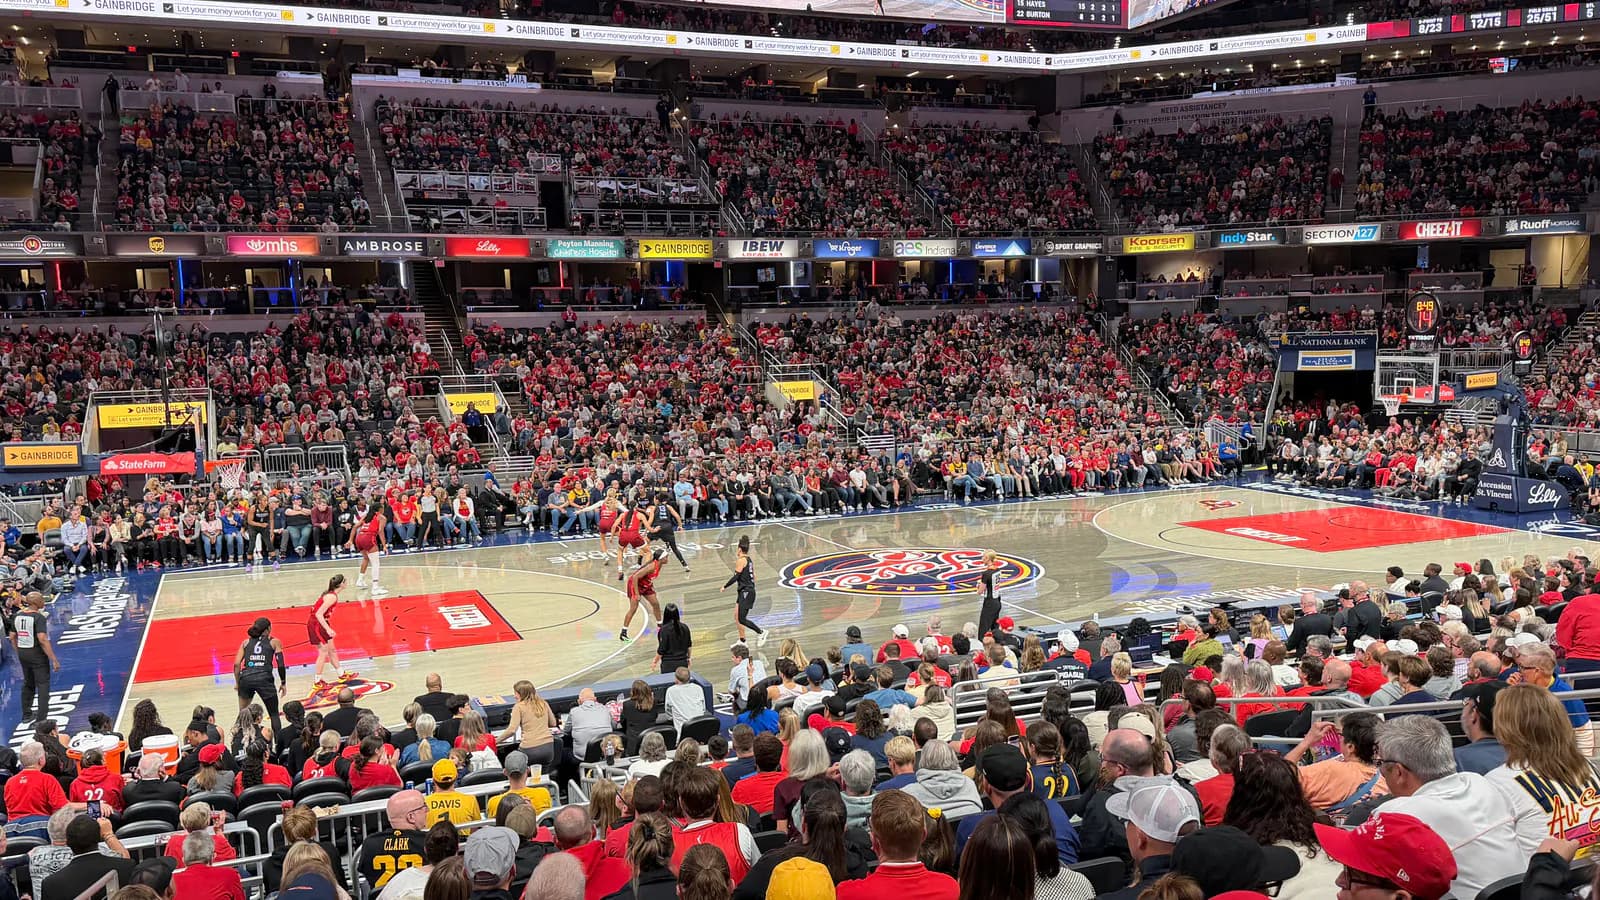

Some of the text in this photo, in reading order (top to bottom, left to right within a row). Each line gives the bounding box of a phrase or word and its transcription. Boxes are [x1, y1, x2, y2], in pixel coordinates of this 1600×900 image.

[95, 0, 155, 12] GAINBRIDGE
[1026, 0, 1046, 8] HAYES
[191, 7, 206, 15] your
[208, 8, 231, 17] money
[1026, 11, 1050, 19] BURTON
[1586, 8, 1594, 18] 5
[317, 12, 370, 25] GAINBRIDGE
[1471, 17, 1501, 29] 12/15
[1527, 12, 1557, 24] 25/51
[403, 20, 416, 28] your
[418, 20, 440, 29] money
[1418, 22, 1442, 34] 8/23
[516, 25, 565, 36] GAINBRIDGE
[594, 32, 606, 40] your
[607, 33, 628, 41] money
[695, 37, 739, 48] GAINBRIDGE
[765, 43, 776, 51] your
[1232, 40, 1243, 48] your
[1244, 39, 1264, 47] money
[856, 46, 897, 57] GAINBRIDGE
[1159, 44, 1204, 57] GAINBRIDGE
[1004, 55, 1040, 65] GAINBRIDGE
[1520, 219, 1579, 230] Ruoff MORTGAGE
[1304, 226, 1374, 241] SECTION 127
[266, 238, 298, 252] mhs
[344, 241, 424, 252] AMBROSE
[558, 240, 613, 248] Peyton Manning
[742, 240, 785, 252] IBEW
[1055, 242, 1073, 250] SPORT
[1075, 241, 1101, 250] GRAPHICS
[1129, 237, 1185, 246] Koorsen
[589, 248, 618, 257] Hospital
[654, 243, 709, 254] GAINBRIDGE
[837, 242, 862, 256] Kroger
[895, 241, 956, 255] aes Indiana
[1418, 311, 1432, 330] 14
[1301, 338, 1343, 346] NATIONAL
[1344, 337, 1367, 345] BANK
[20, 451, 73, 461] GAINBRIDGE
[1477, 480, 1512, 491] Ascension
[1486, 490, 1512, 500] Vincent
[1528, 483, 1562, 508] Lilly
[21, 619, 27, 631] 11
[254, 641, 262, 654] 6
[84, 788, 104, 801] 22
[431, 799, 461, 811] DAVIS
[384, 838, 410, 851] CLARK
